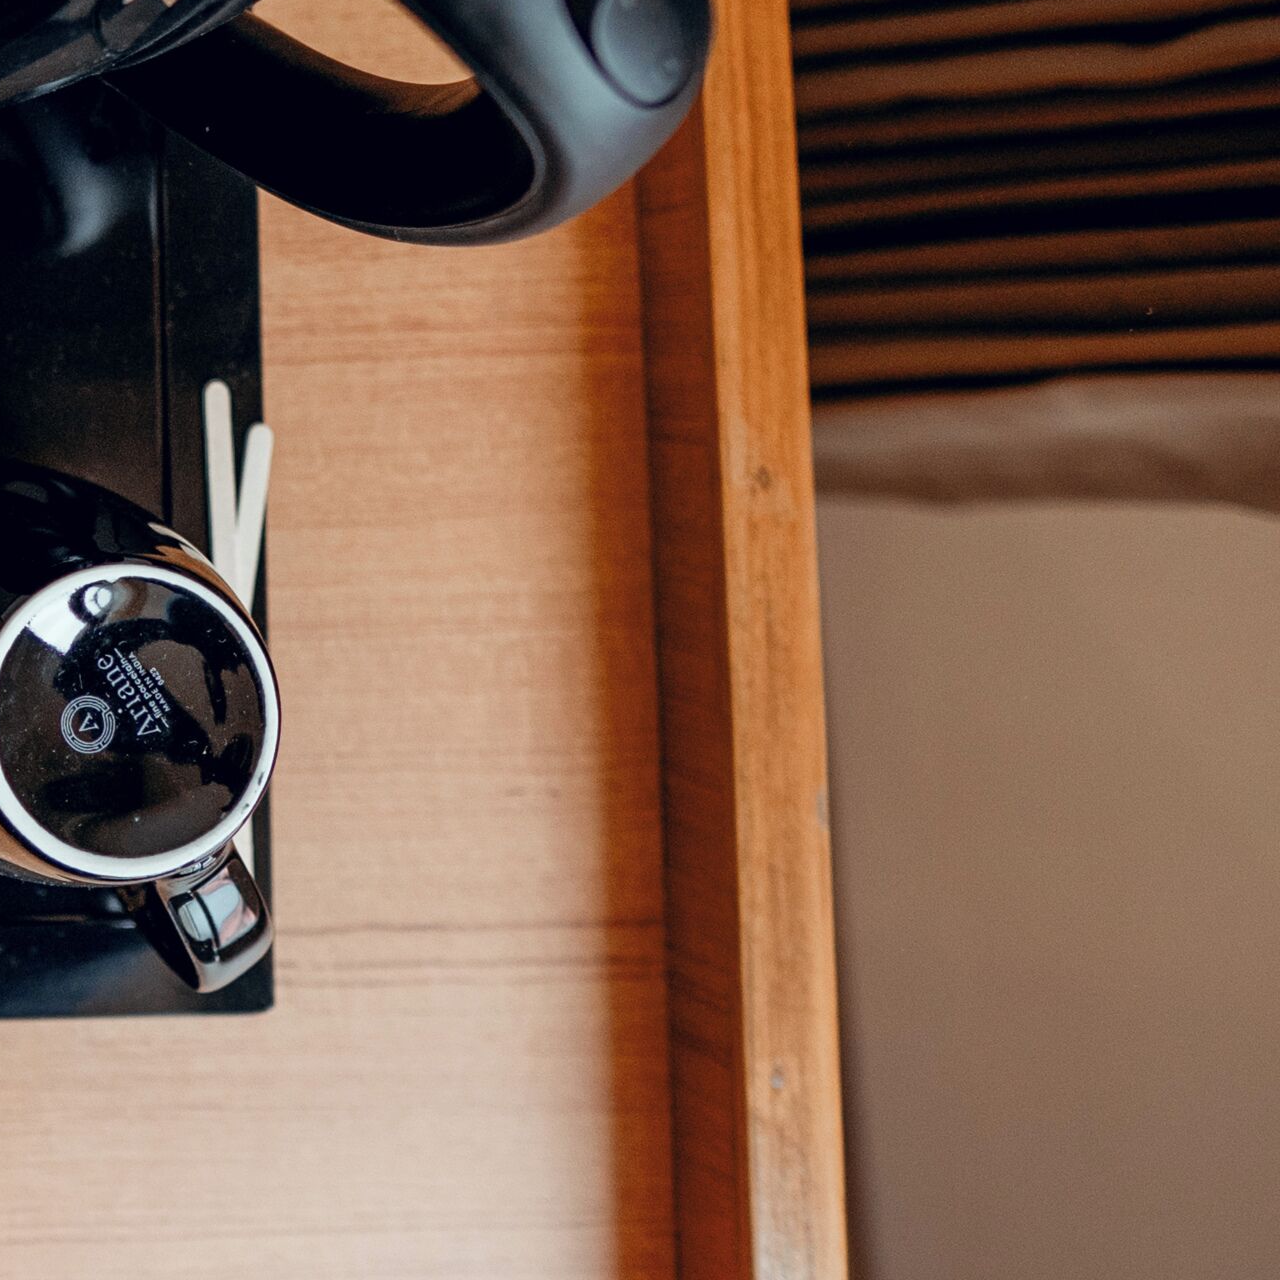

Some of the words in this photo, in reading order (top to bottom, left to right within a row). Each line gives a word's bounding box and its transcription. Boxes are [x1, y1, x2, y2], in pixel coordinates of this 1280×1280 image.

[128, 651, 147, 677] INDIA
[120, 657, 153, 700] porcelain
[143, 676, 154, 688] IN
[97, 654, 162, 736] Ariane
[151, 688, 171, 712] MADE
[148, 701, 162, 719] fine
